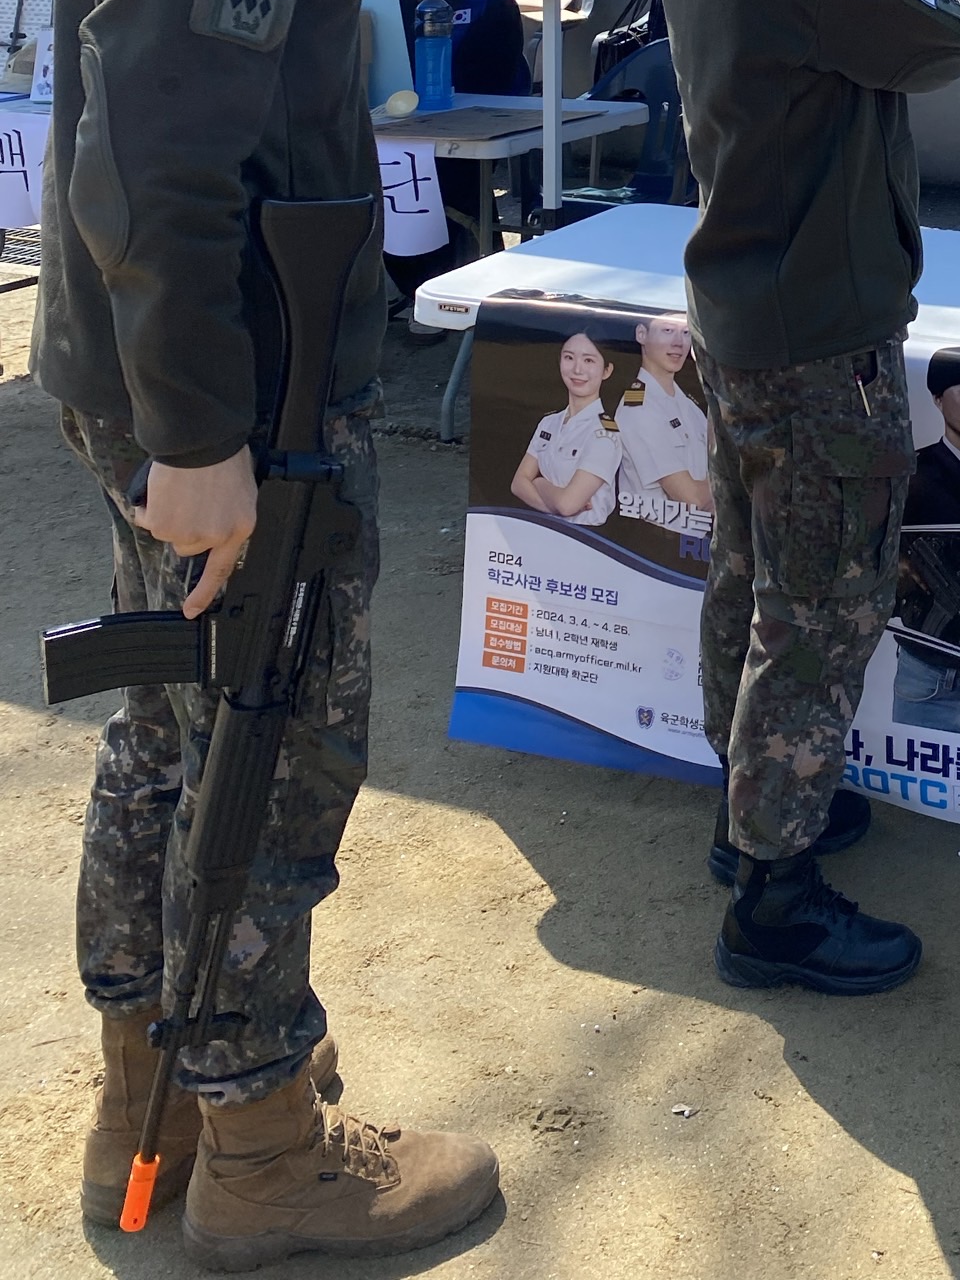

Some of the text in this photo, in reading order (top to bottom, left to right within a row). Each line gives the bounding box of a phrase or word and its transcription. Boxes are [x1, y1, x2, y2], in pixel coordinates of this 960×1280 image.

[618, 492, 713, 532] 앞서가는
[488, 550, 523, 568] 2024
[487, 568, 619, 606] 학군사관 후보생 모집
[535, 627, 553, 639] 남녀
[563, 632, 588, 646] 2학년
[590, 637, 618, 651] 재학생
[533, 662, 569, 678] 지원대학
[571, 669, 599, 684] 학군단
[534, 646, 643, 674] acq.armyofficer.mil.kr
[840, 764, 948, 810] ROTC
